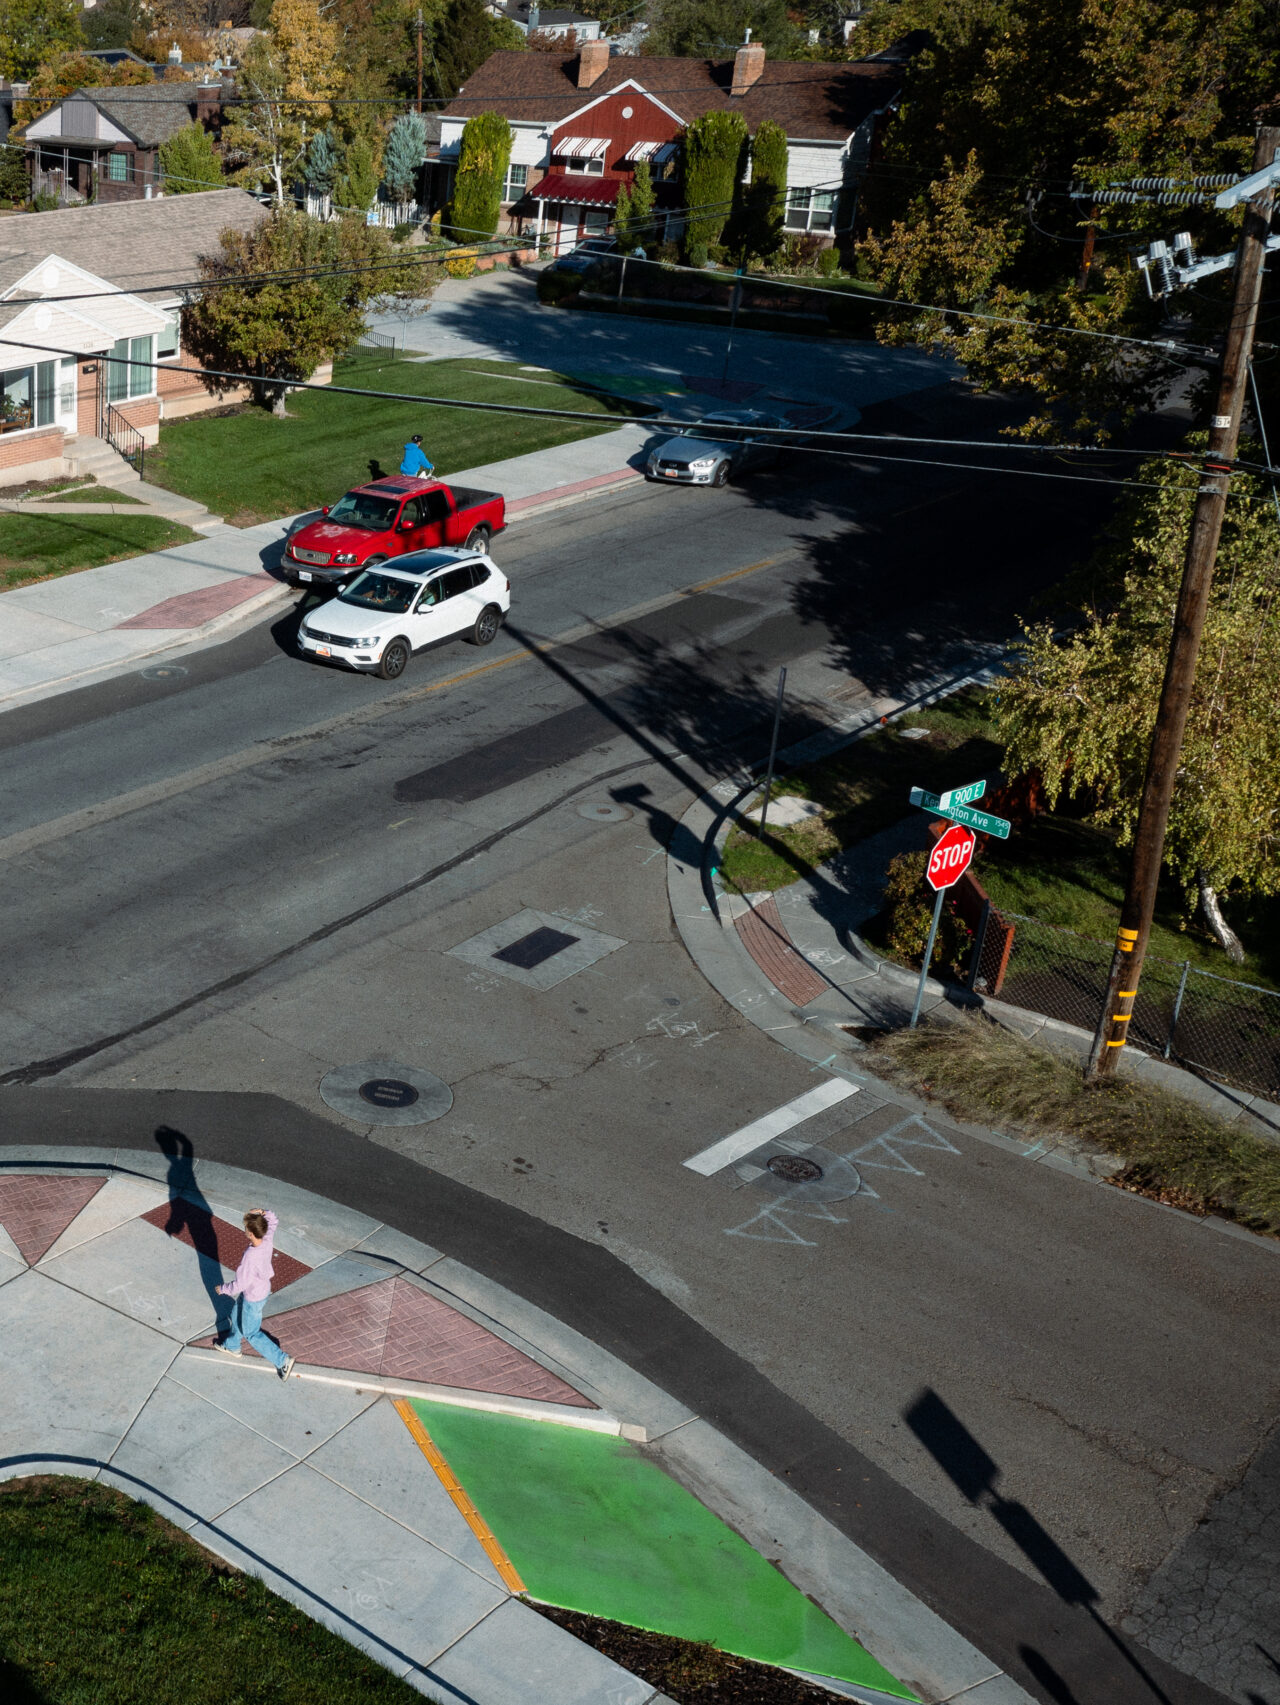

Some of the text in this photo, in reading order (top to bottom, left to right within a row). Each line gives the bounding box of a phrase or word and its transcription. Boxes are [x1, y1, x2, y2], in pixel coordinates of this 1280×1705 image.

[955, 784, 980, 804] 900 E
[971, 812, 988, 827] Ave
[995, 819, 1008, 830] 1545
[931, 841, 972, 873] STOP
